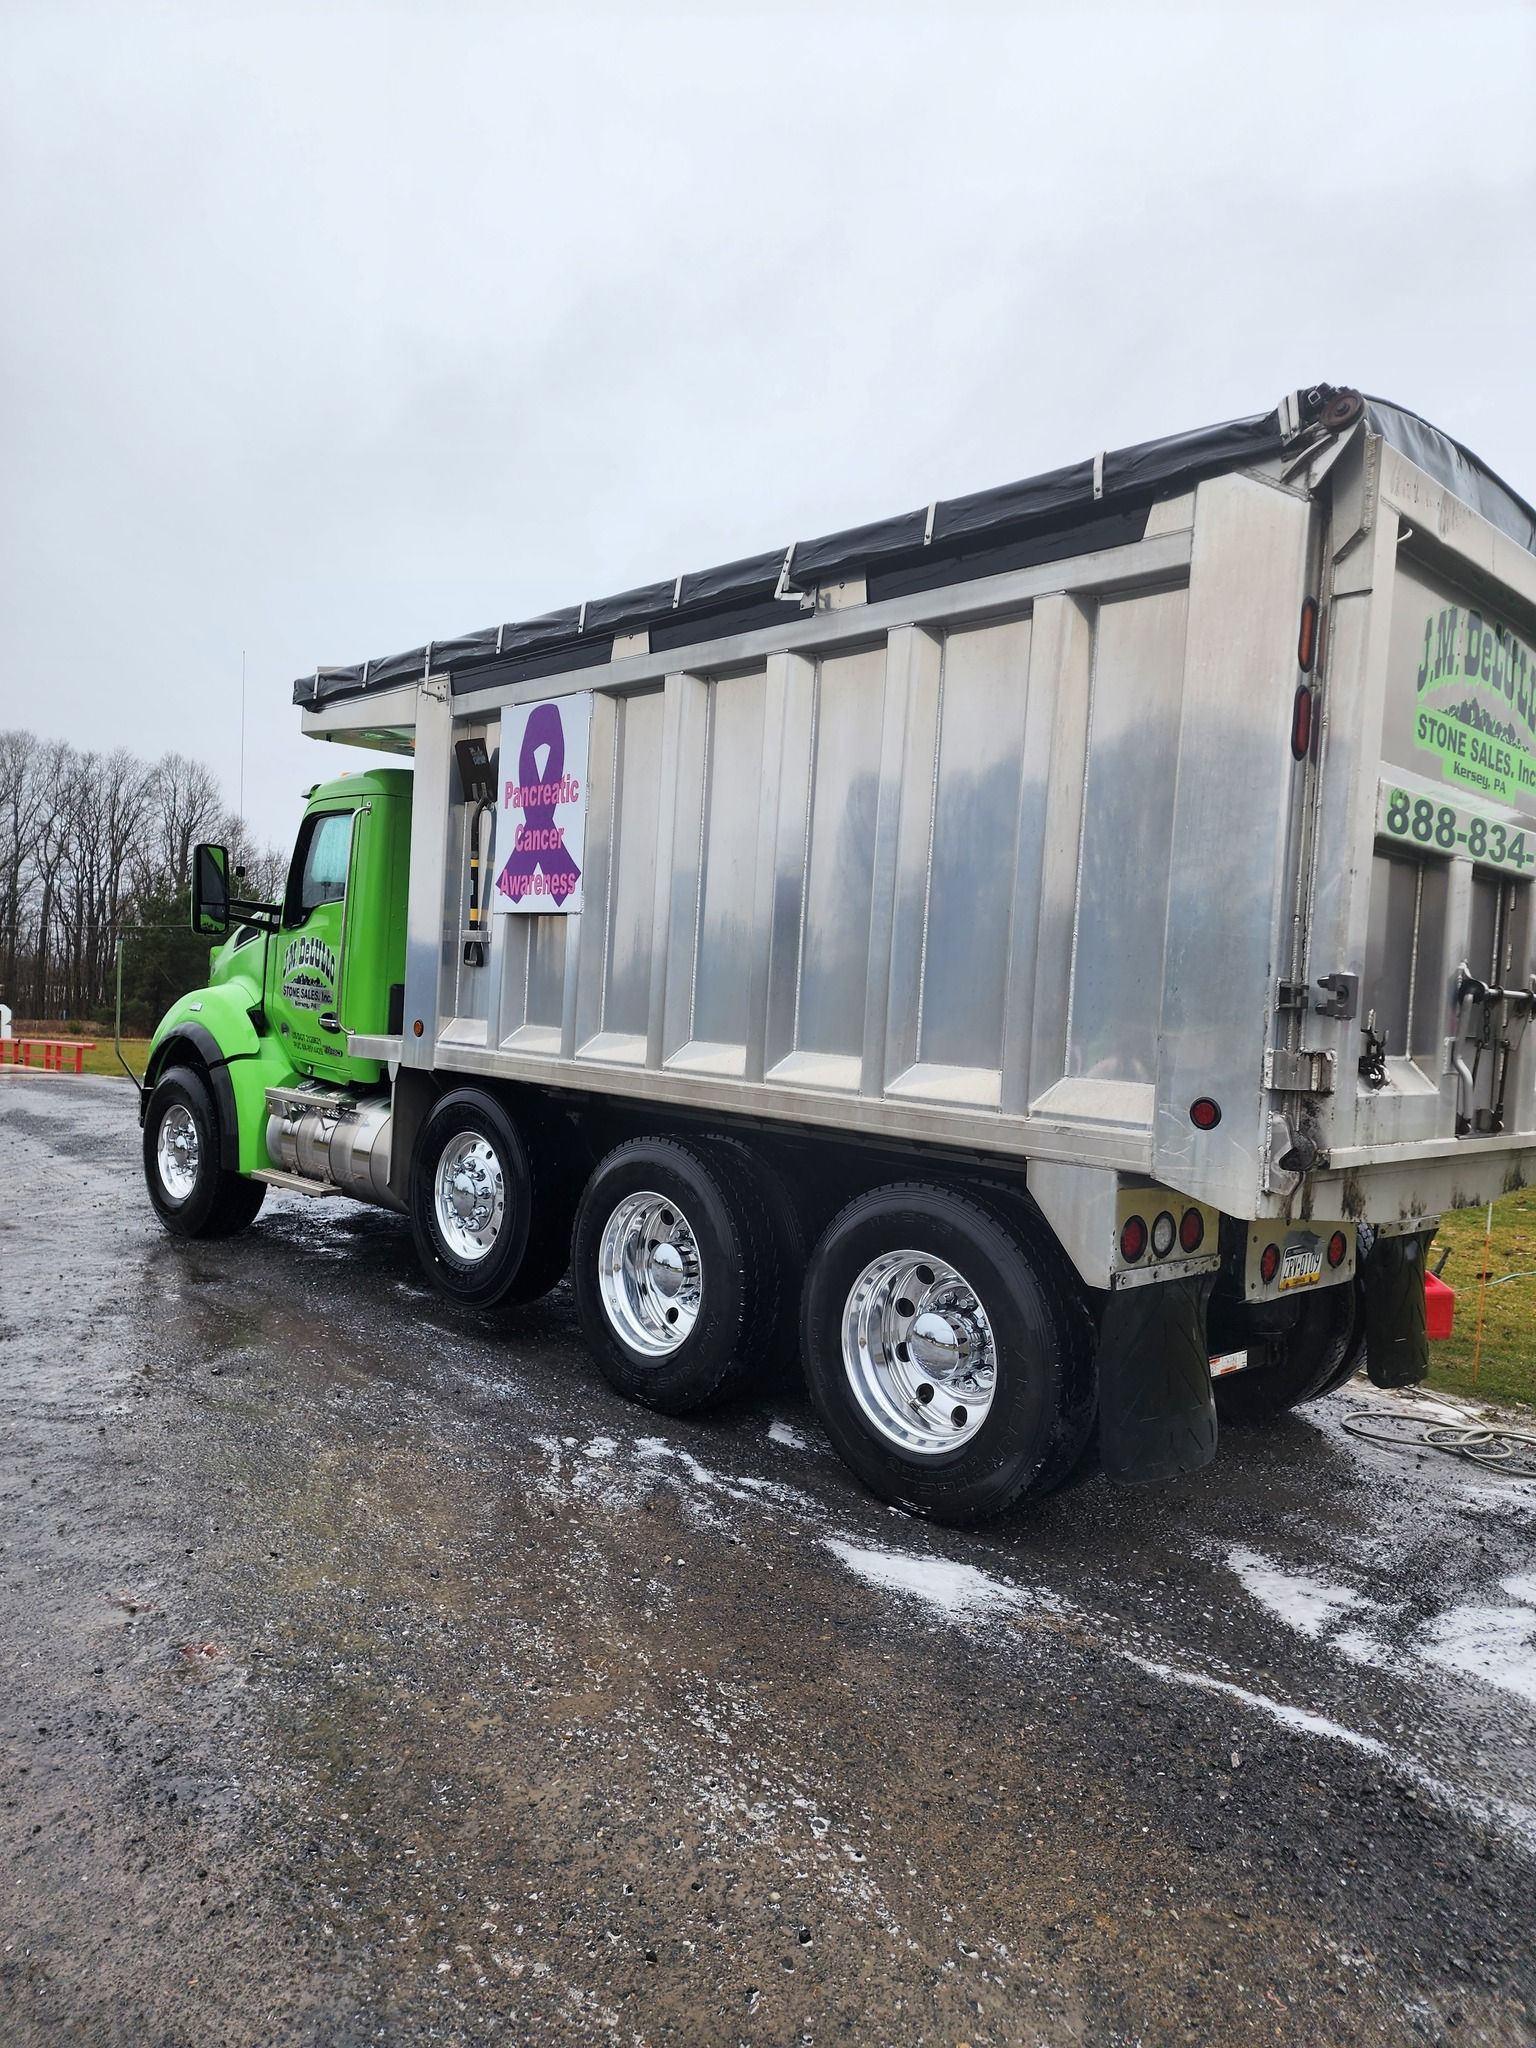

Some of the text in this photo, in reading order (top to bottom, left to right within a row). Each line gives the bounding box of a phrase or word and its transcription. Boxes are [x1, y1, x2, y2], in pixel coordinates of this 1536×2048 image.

[1417, 607, 1459, 692] J.M.
[1417, 713, 1466, 758] STONE
[504, 774, 580, 810] Pancreatic
[1453, 761, 1506, 794] Kersey, PA
[514, 823, 565, 852] Cancer
[499, 868, 576, 897] Awareness
[283, 985, 300, 998] STONE
